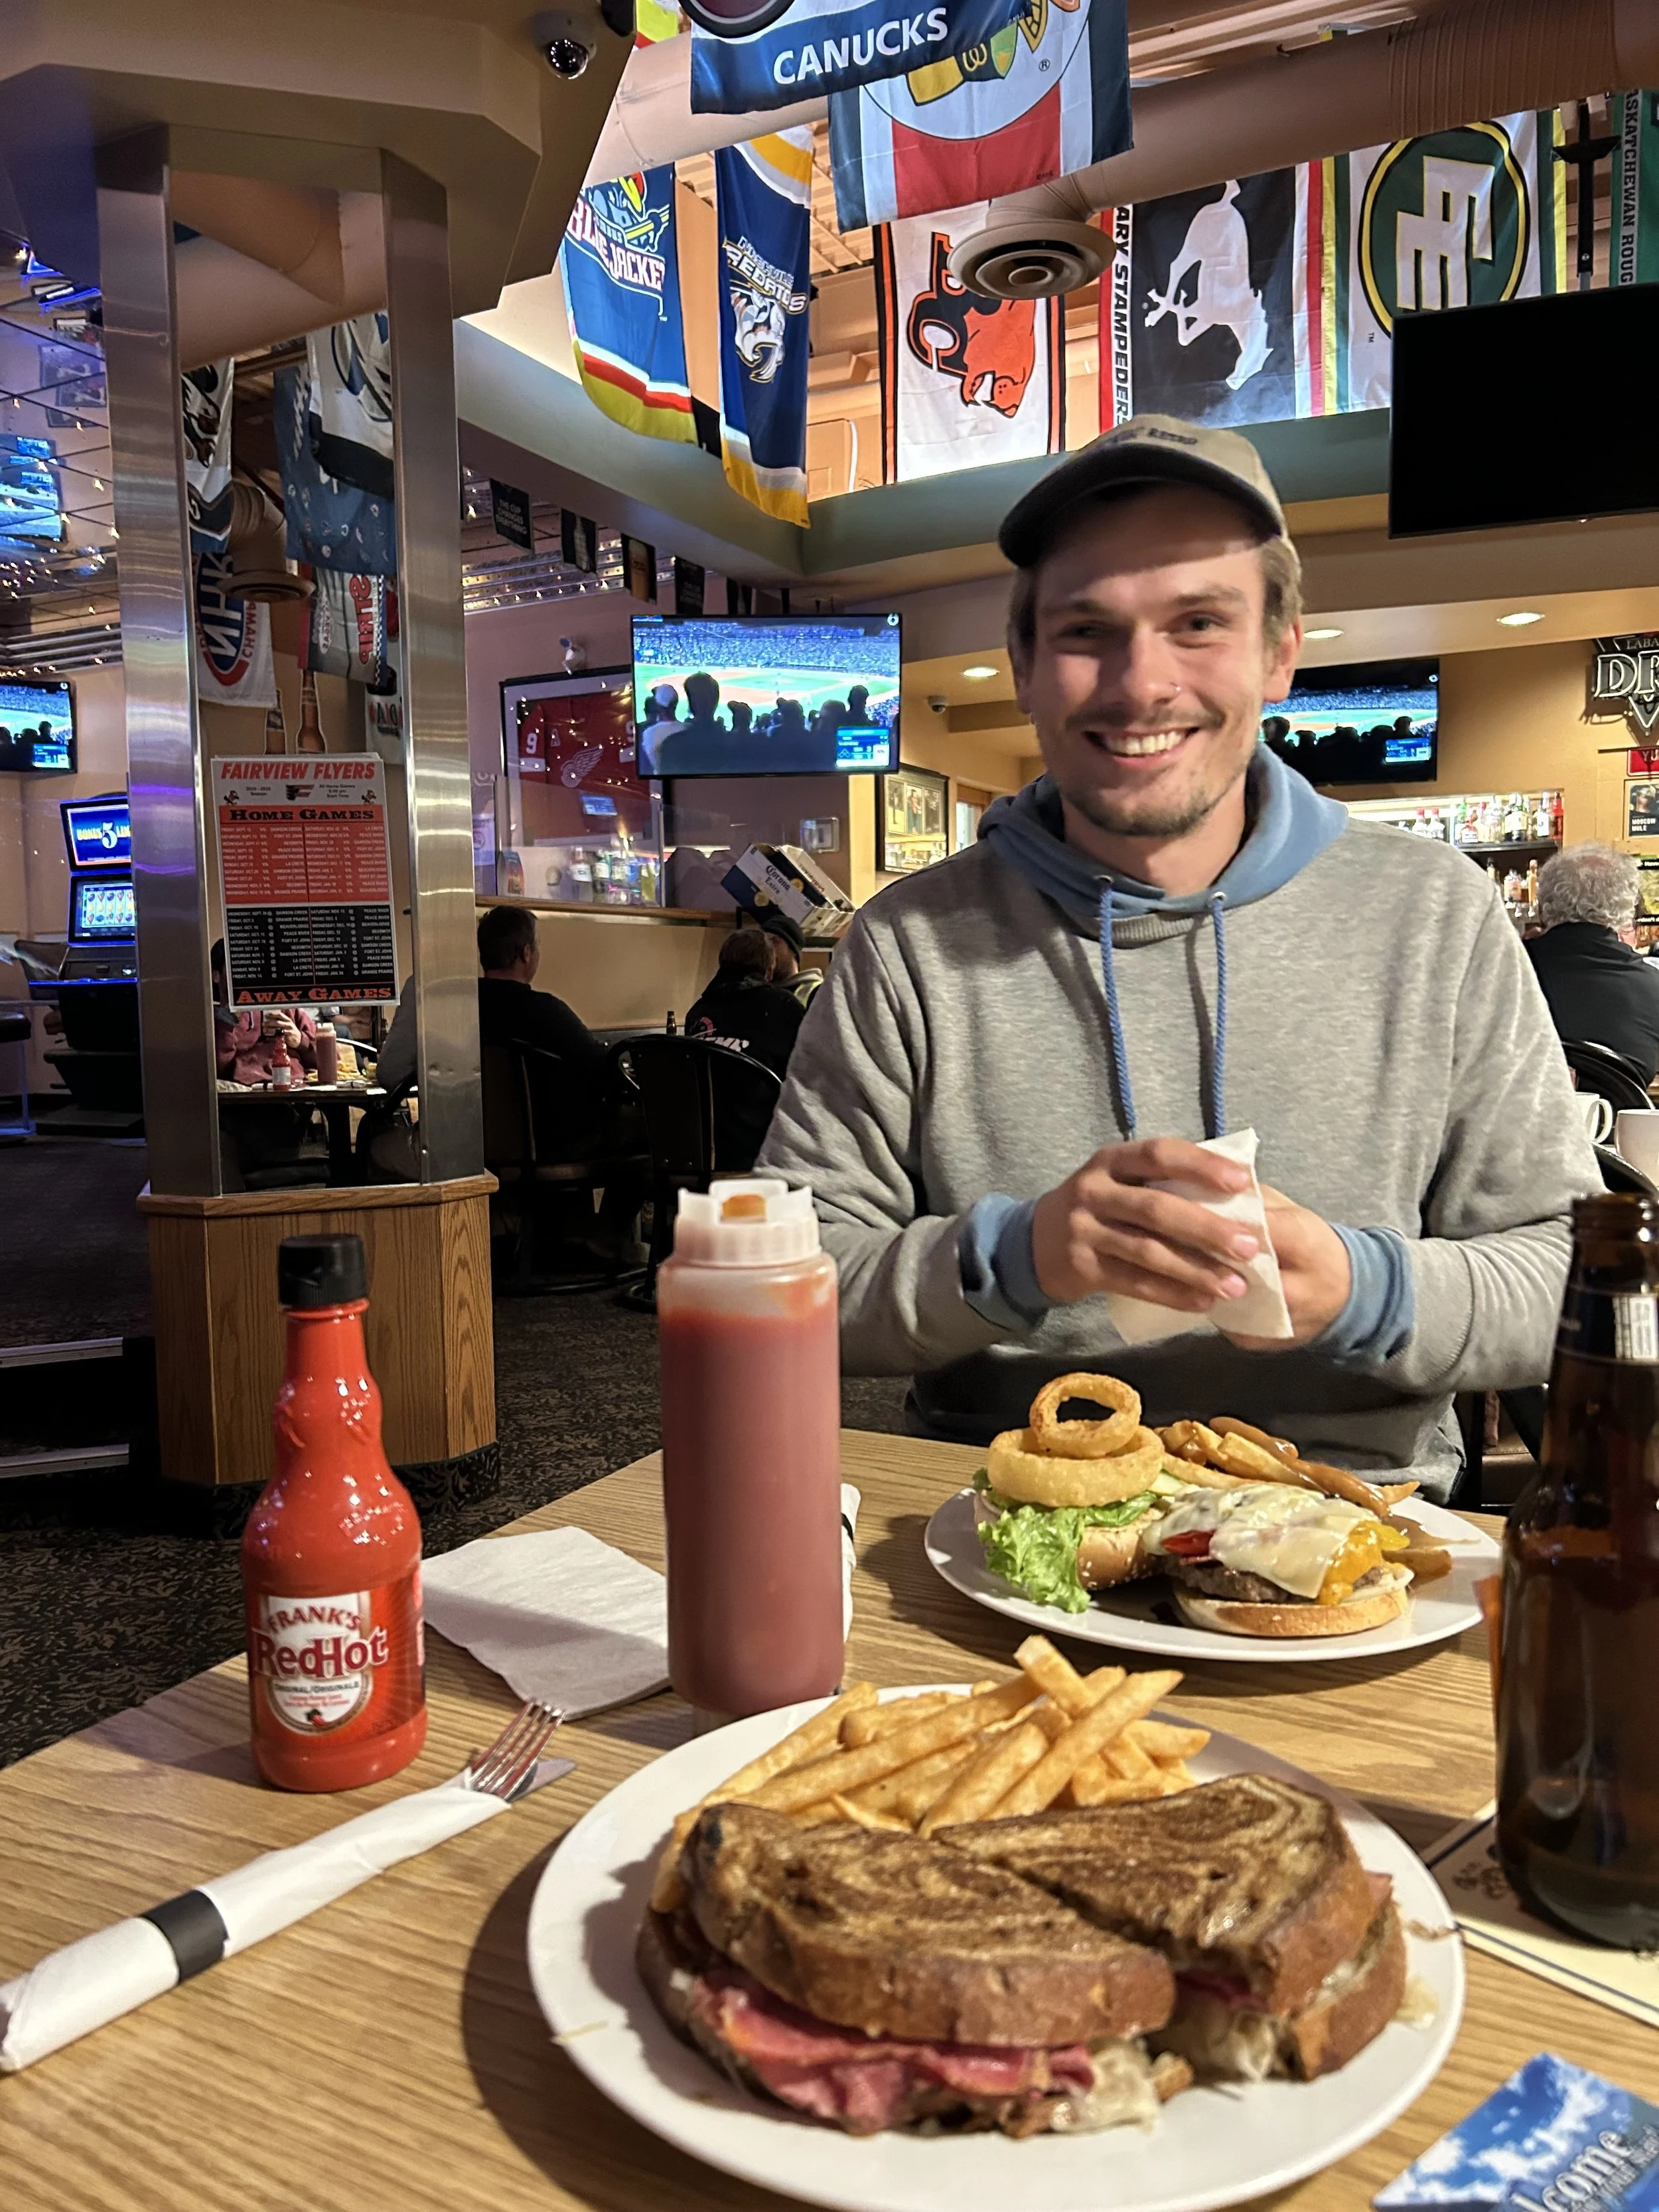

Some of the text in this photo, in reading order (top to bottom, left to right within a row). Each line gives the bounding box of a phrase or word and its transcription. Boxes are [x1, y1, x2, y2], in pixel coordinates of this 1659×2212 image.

[773, 7, 948, 84] CANUCKS
[526, 733, 538, 754] 9
[221, 761, 375, 780] FAIRVIEW FLYERS
[230, 808, 374, 821] HOME GAMES
[102, 822, 117, 849] 5
[766, 865, 792, 891] Corona
[237, 988, 392, 1003] AWAY GAMES
[267, 1606, 362, 1635] FRANK'S
[255, 1627, 389, 1679] RedHot
